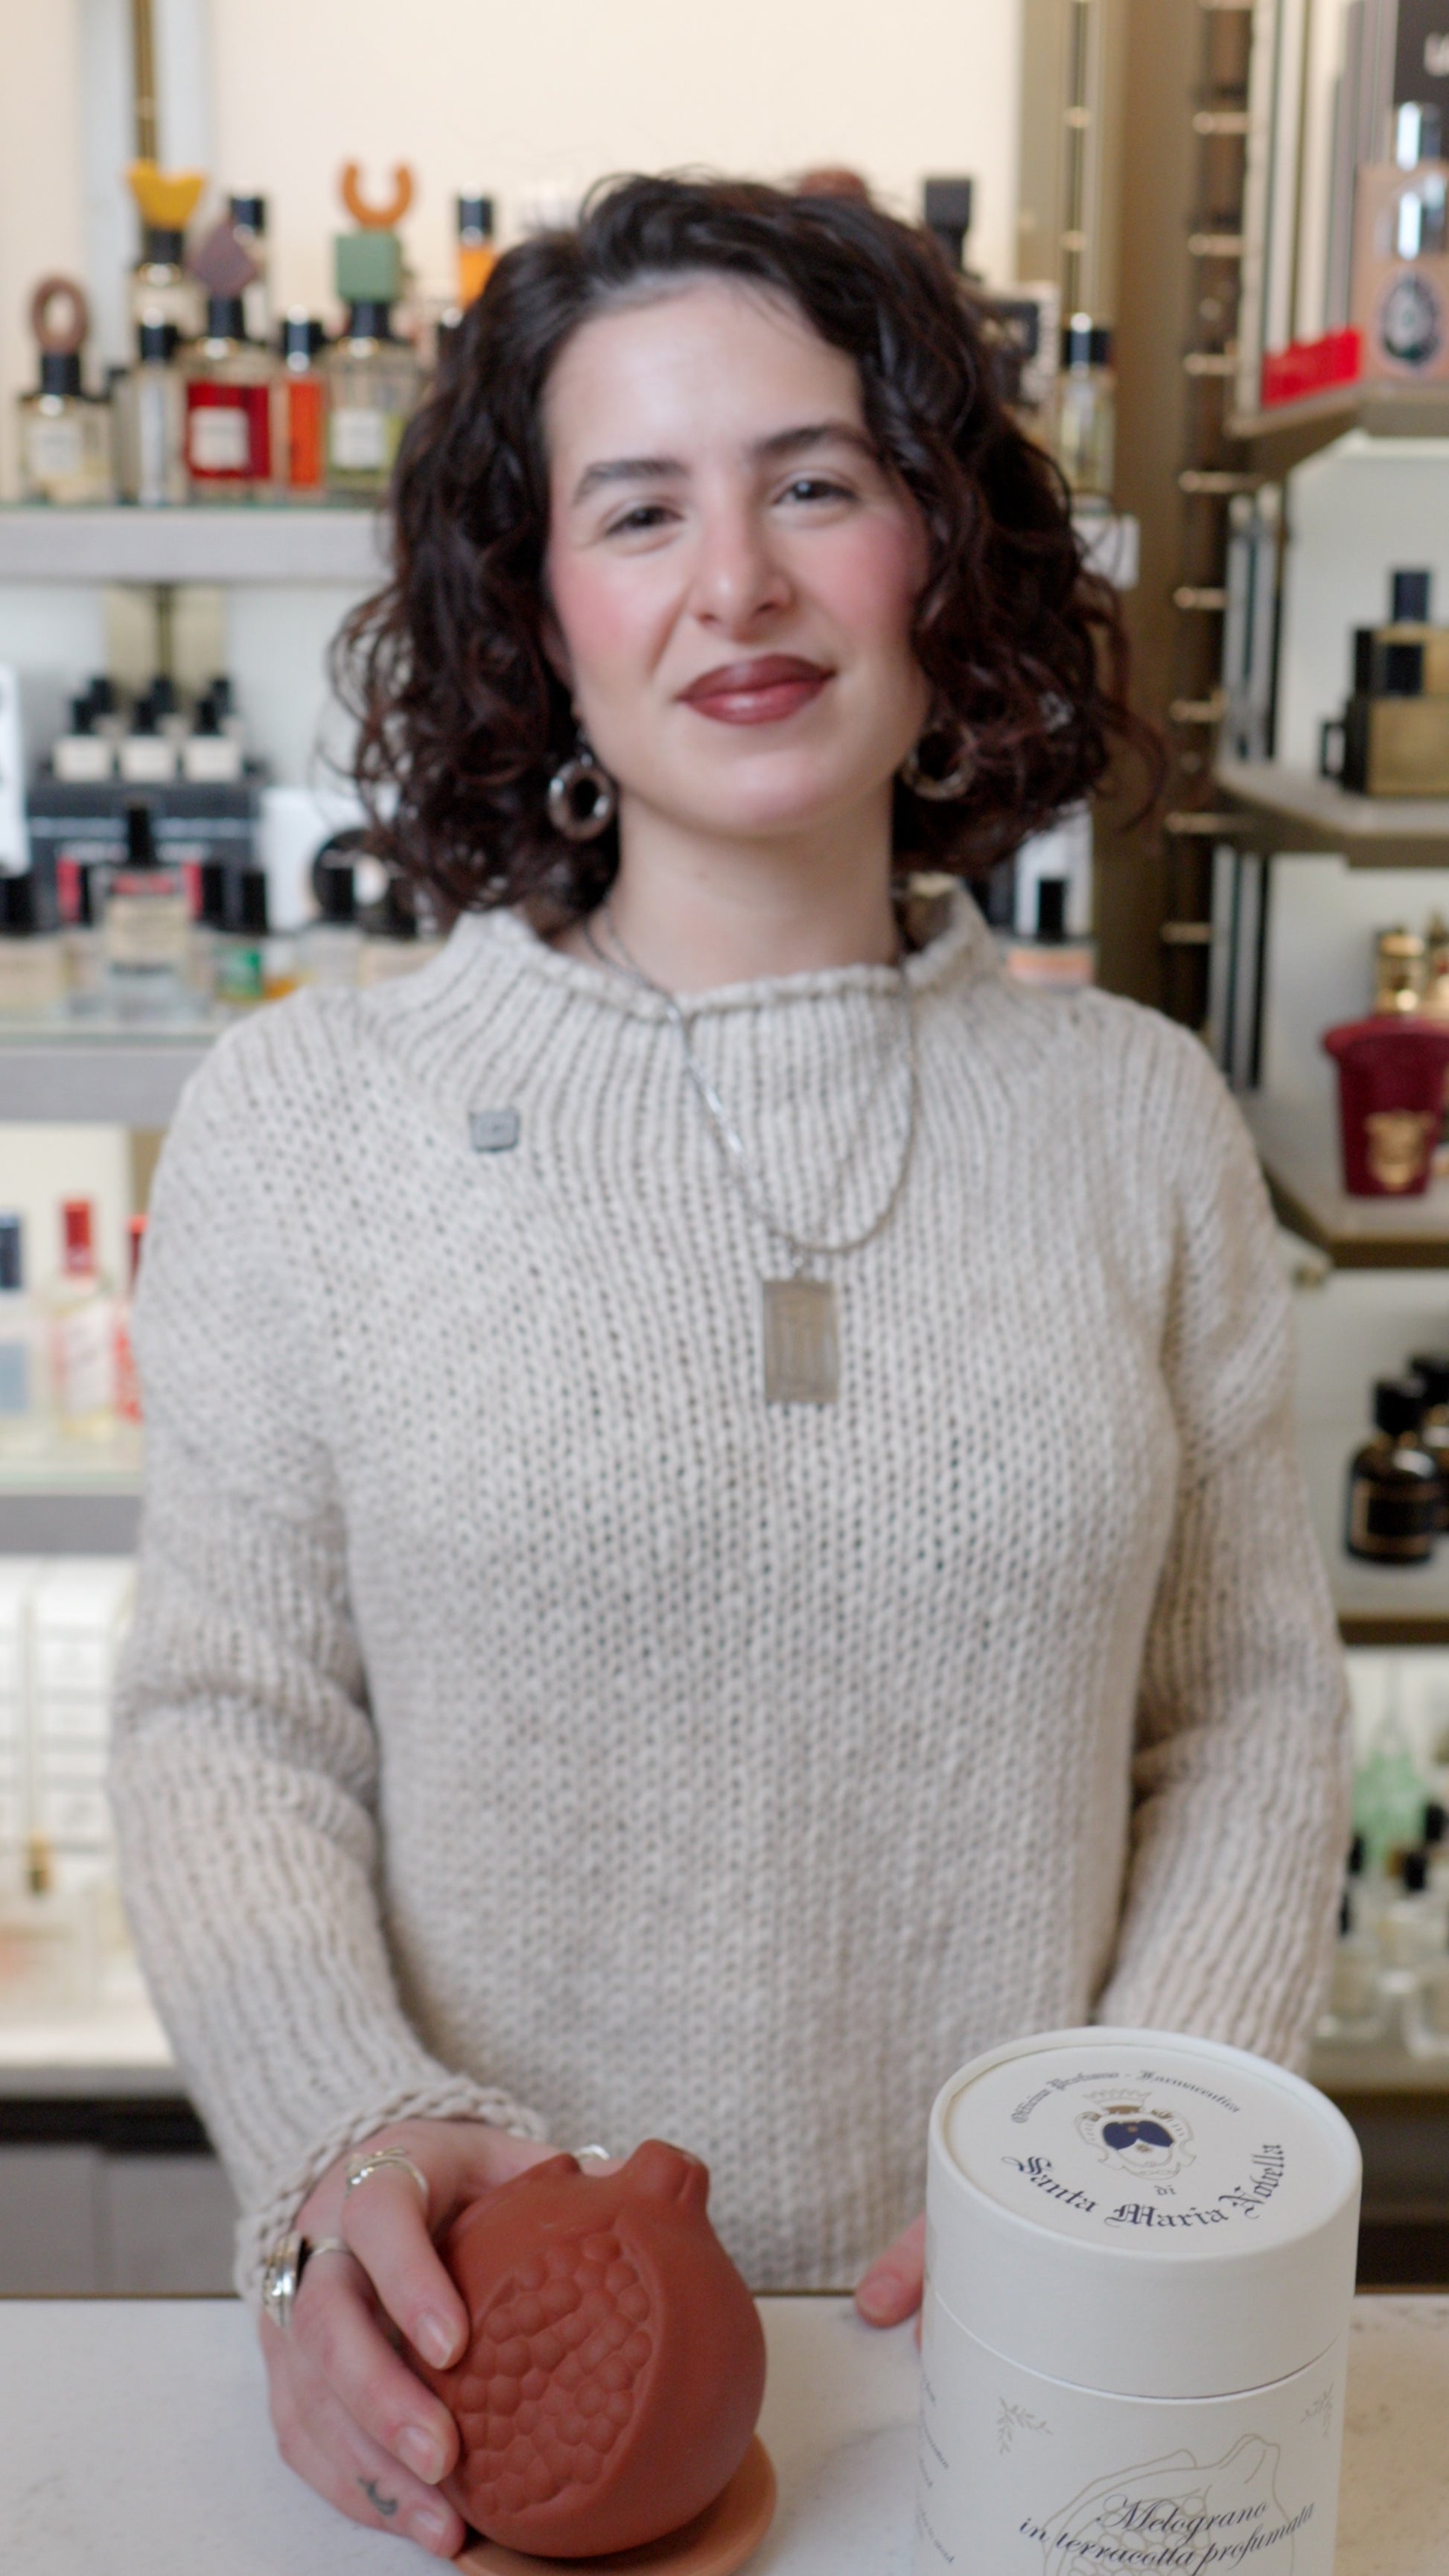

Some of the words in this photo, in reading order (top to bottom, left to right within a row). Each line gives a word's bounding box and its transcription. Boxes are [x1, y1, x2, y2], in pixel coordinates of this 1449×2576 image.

[1001, 2156, 1097, 2213] Santa
[1104, 2203, 1229, 2228] Maria
[1218, 2144, 1284, 2219] Novella
[1155, 2184, 1176, 2196] di
[1019, 2517, 1048, 2541] in
[1056, 2533, 1196, 2568] terracotta
[1191, 2502, 1315, 2576] profumata
[1095, 2494, 1267, 2546] Melograno
